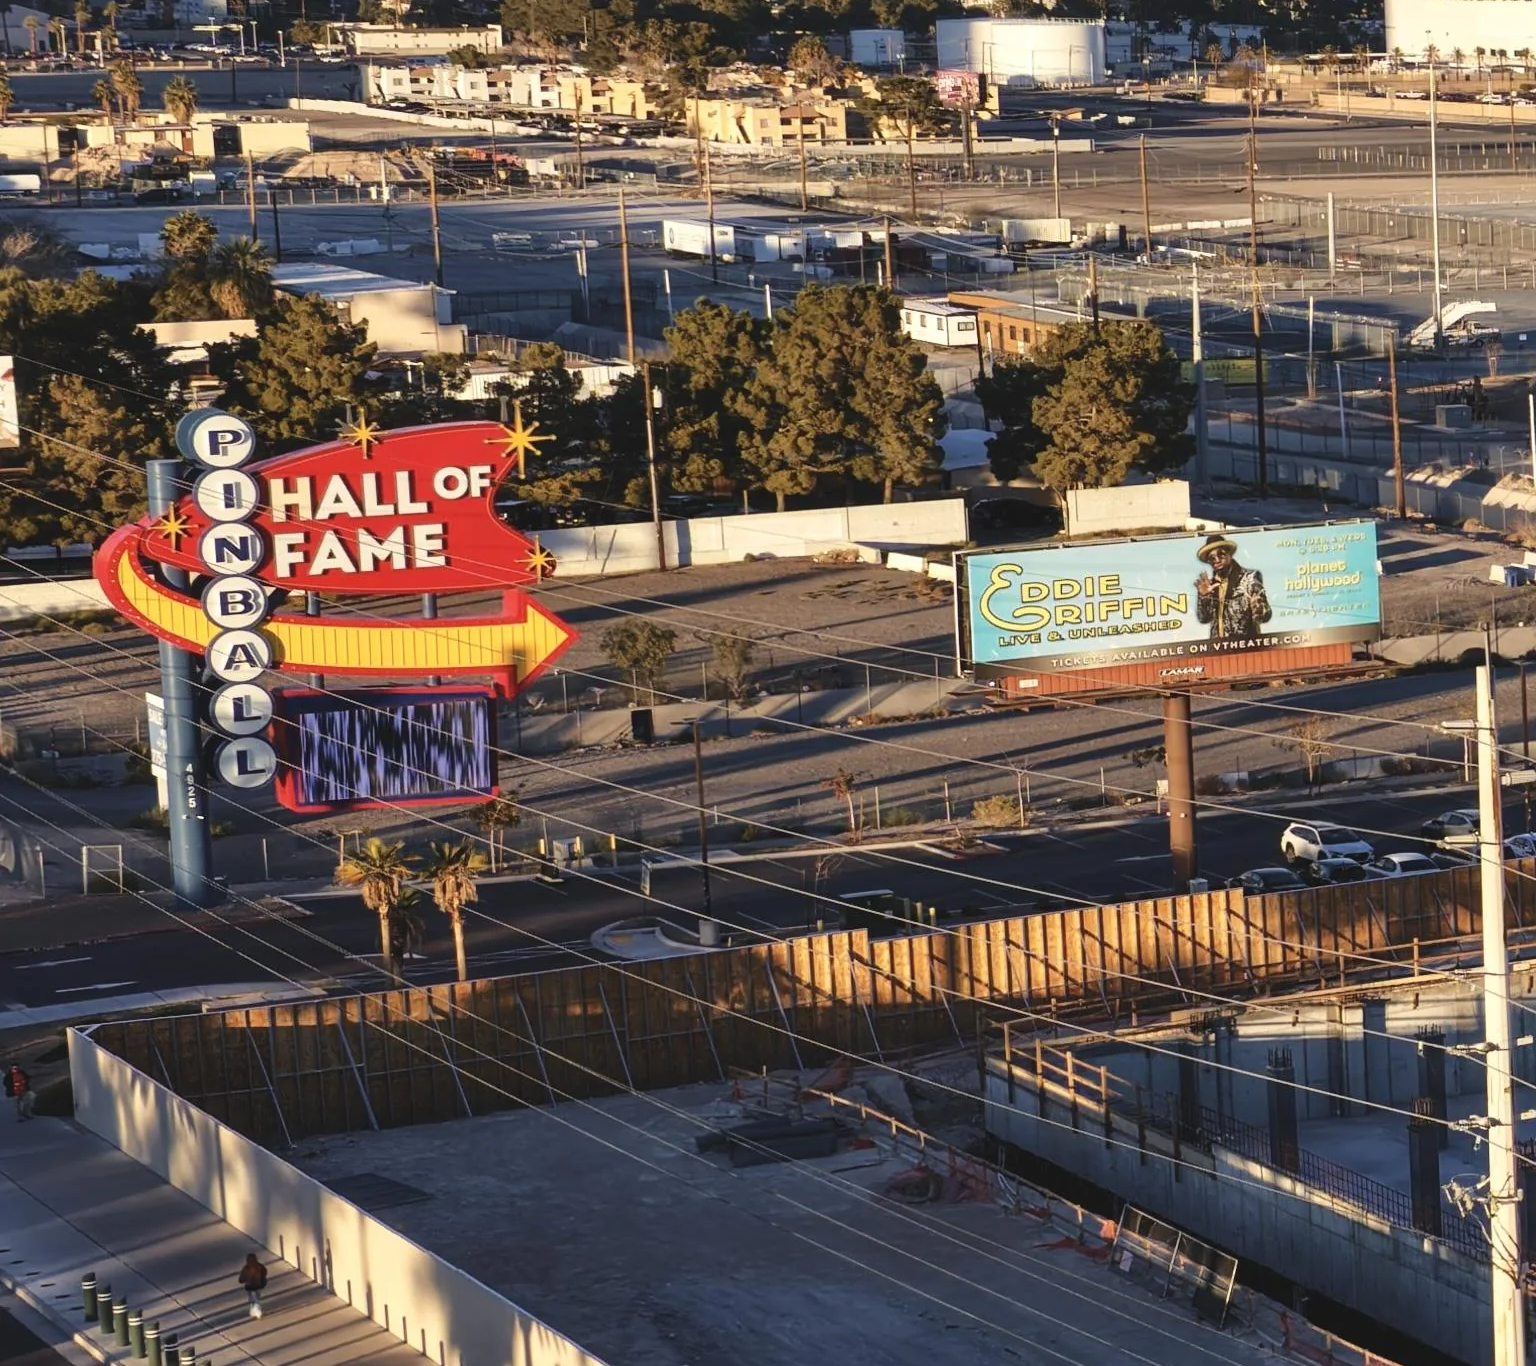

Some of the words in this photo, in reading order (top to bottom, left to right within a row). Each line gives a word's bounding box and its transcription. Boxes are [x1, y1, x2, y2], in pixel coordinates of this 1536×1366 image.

[270, 471, 429, 522] HALL
[433, 465, 492, 500] OF
[274, 523, 447, 578] FAME
[1297, 560, 1347, 576] planet
[980, 563, 1123, 603] EDDIE
[1284, 571, 1362, 592] hollywood
[208, 430, 267, 776] PINBALL
[980, 593, 1188, 633] GRIFFIN
[998, 632, 1042, 647] LIVE
[1047, 629, 1062, 641] &
[1068, 619, 1183, 639] UNLEASHED
[1051, 654, 1107, 668] TICKETS
[1112, 645, 1185, 662] AVAILABLE
[1189, 644, 1208, 654] ON
[1213, 633, 1312, 651] VTHEATER.COM
[1159, 666, 1206, 676] LAMAR
[185, 763, 197, 808] 4925
